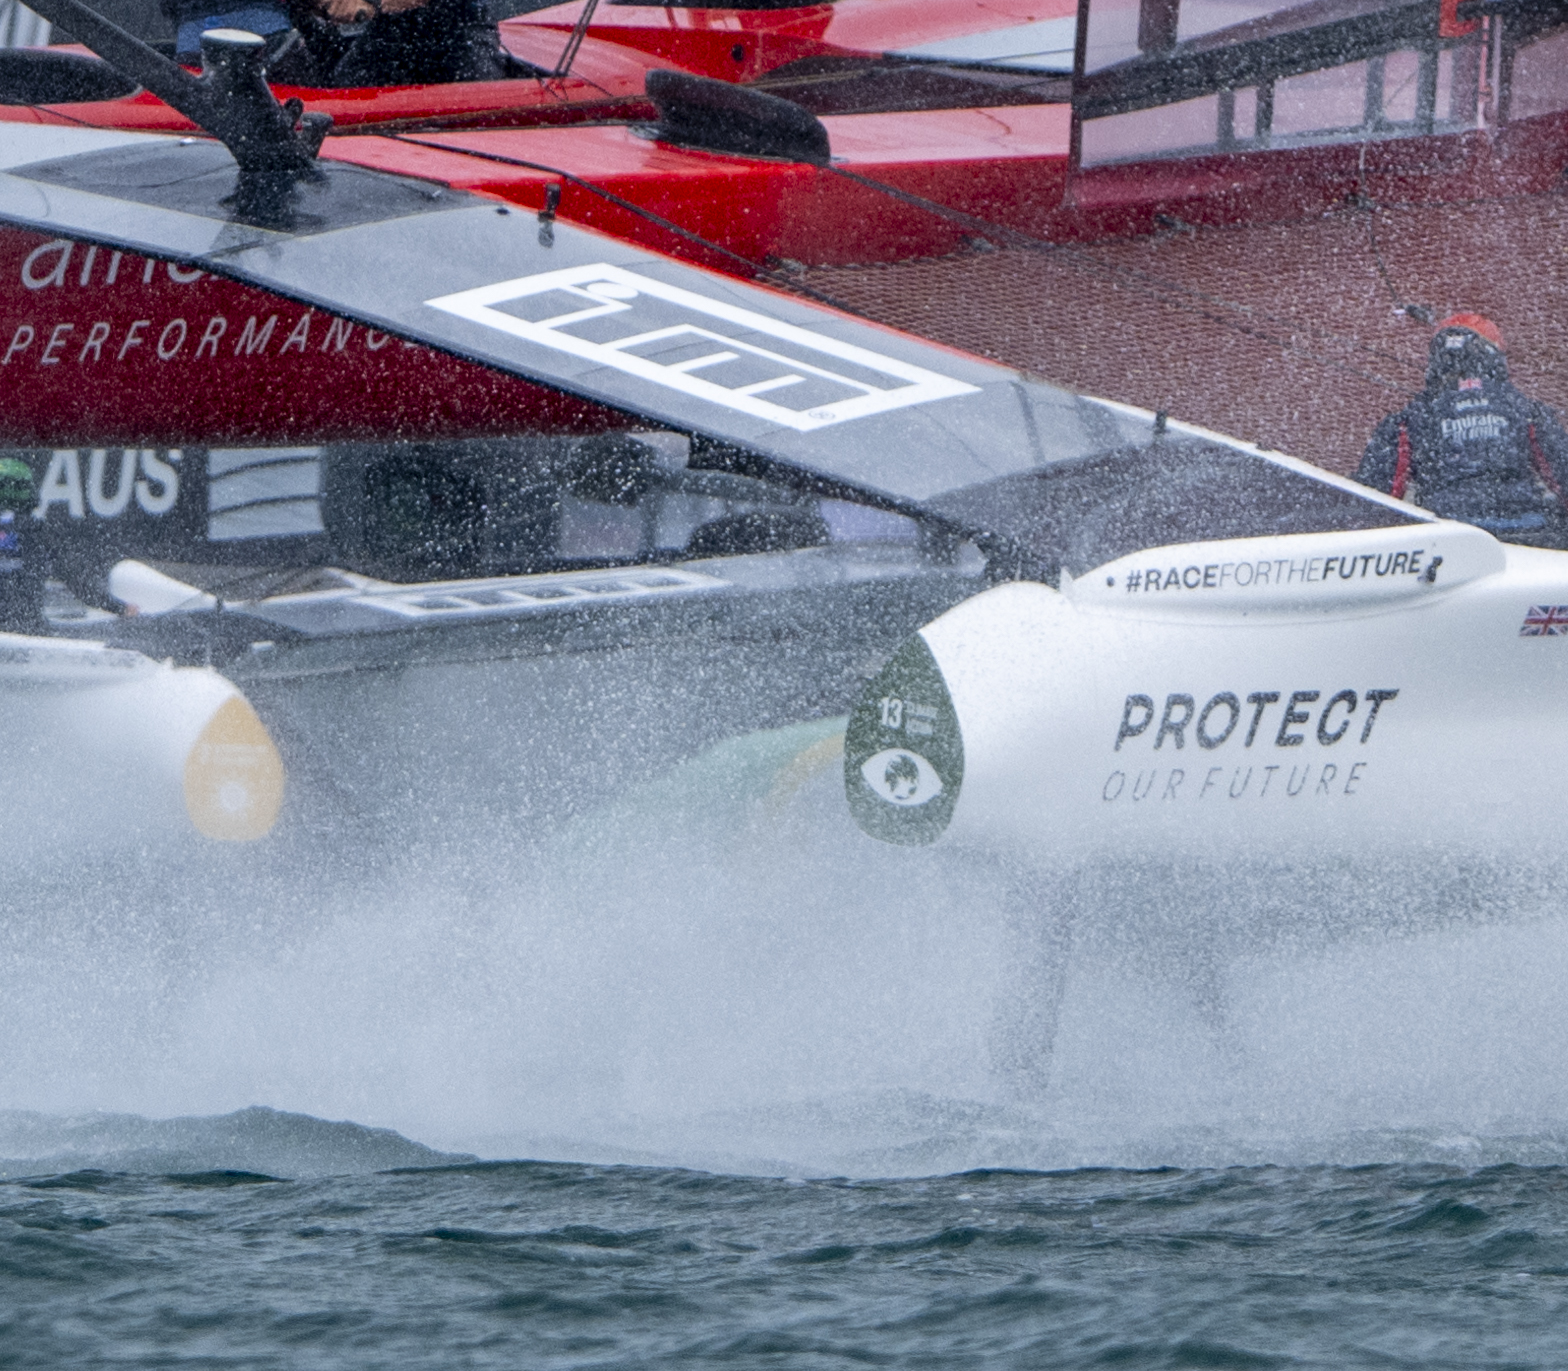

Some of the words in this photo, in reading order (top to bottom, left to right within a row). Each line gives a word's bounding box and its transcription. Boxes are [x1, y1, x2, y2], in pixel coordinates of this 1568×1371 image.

[1, 310, 421, 366] PERFORMANC
[32, 449, 183, 519] AUS
[1127, 550, 1425, 593] #RACEFORTHEFUTURE
[881, 697, 904, 730] 13
[1114, 688, 1401, 752] PROTECT
[1102, 766, 1186, 802] OUR
[1198, 761, 1368, 801] FUTURE
